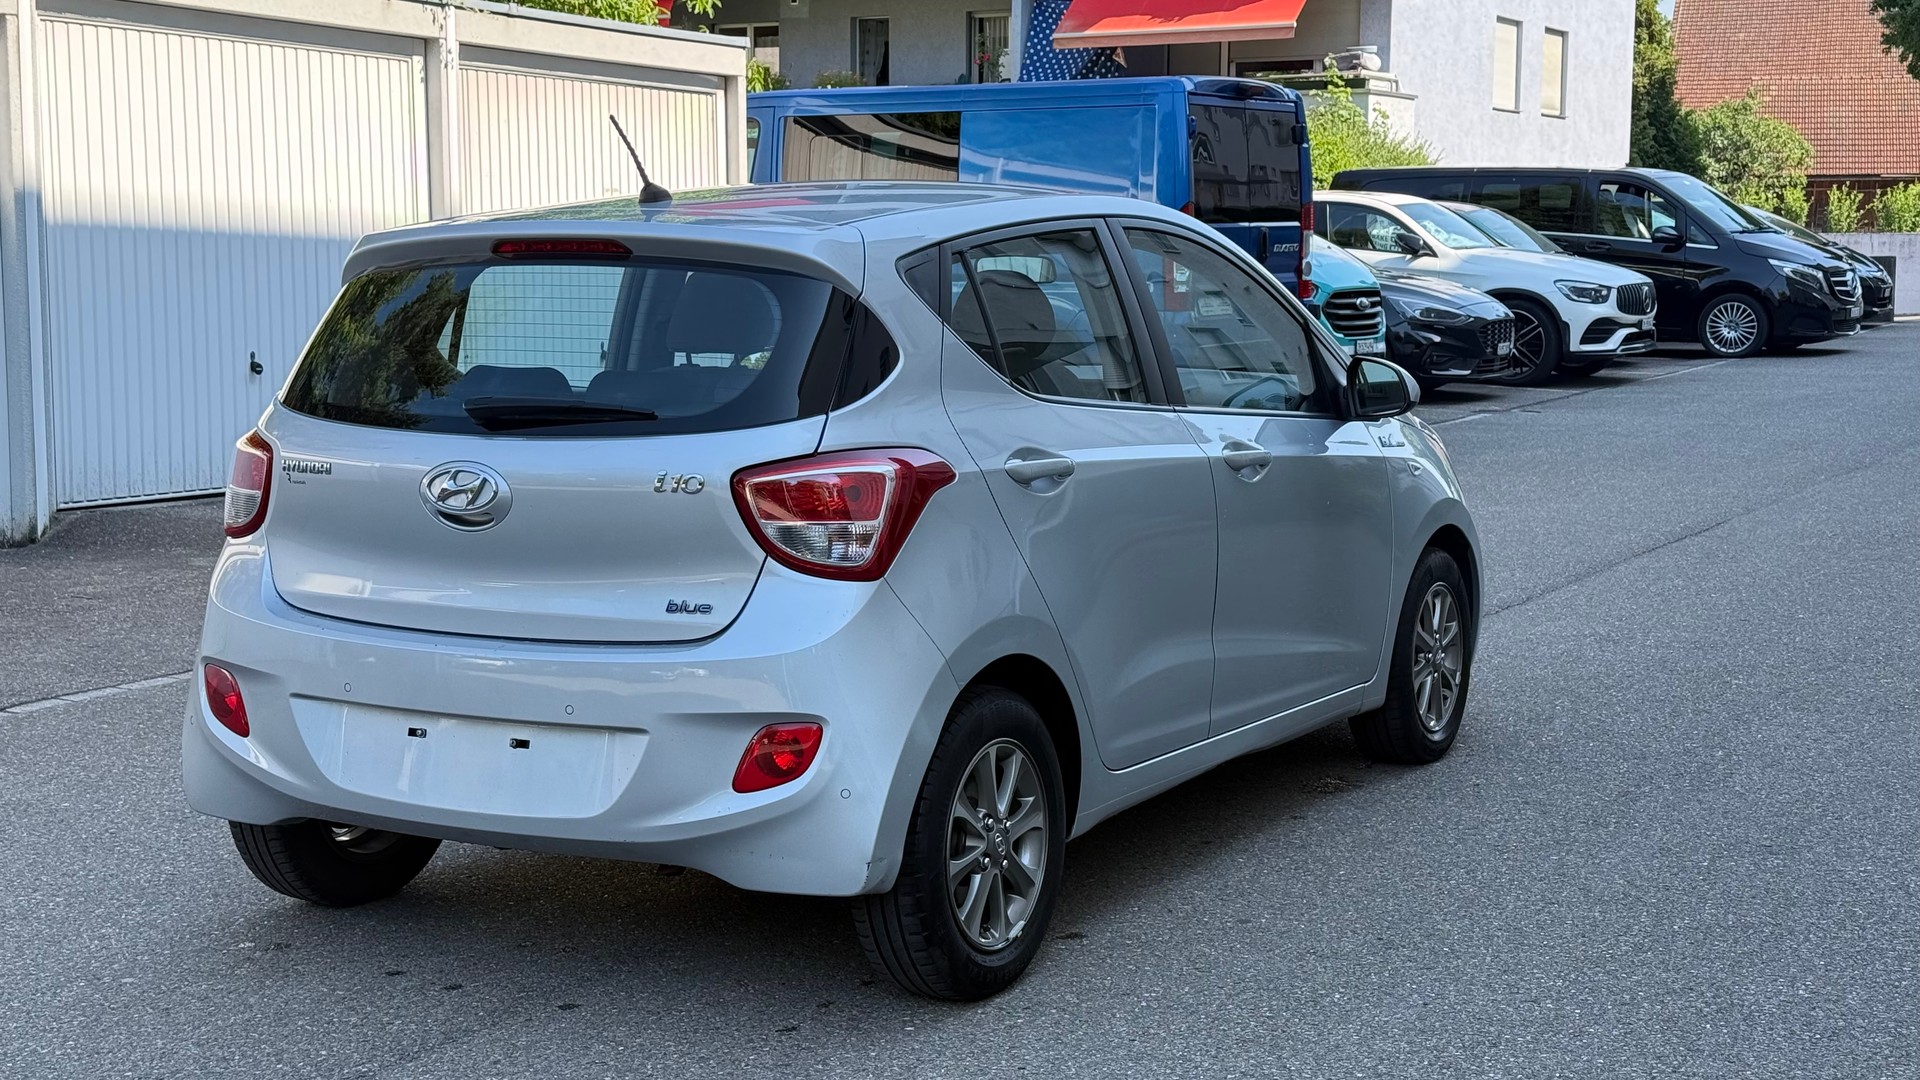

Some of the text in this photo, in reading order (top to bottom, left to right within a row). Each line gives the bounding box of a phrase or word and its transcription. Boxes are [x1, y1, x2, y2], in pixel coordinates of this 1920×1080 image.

[282, 459, 332, 475] HYUNDAI
[654, 470, 705, 495] i10
[665, 599, 713, 615] blue
